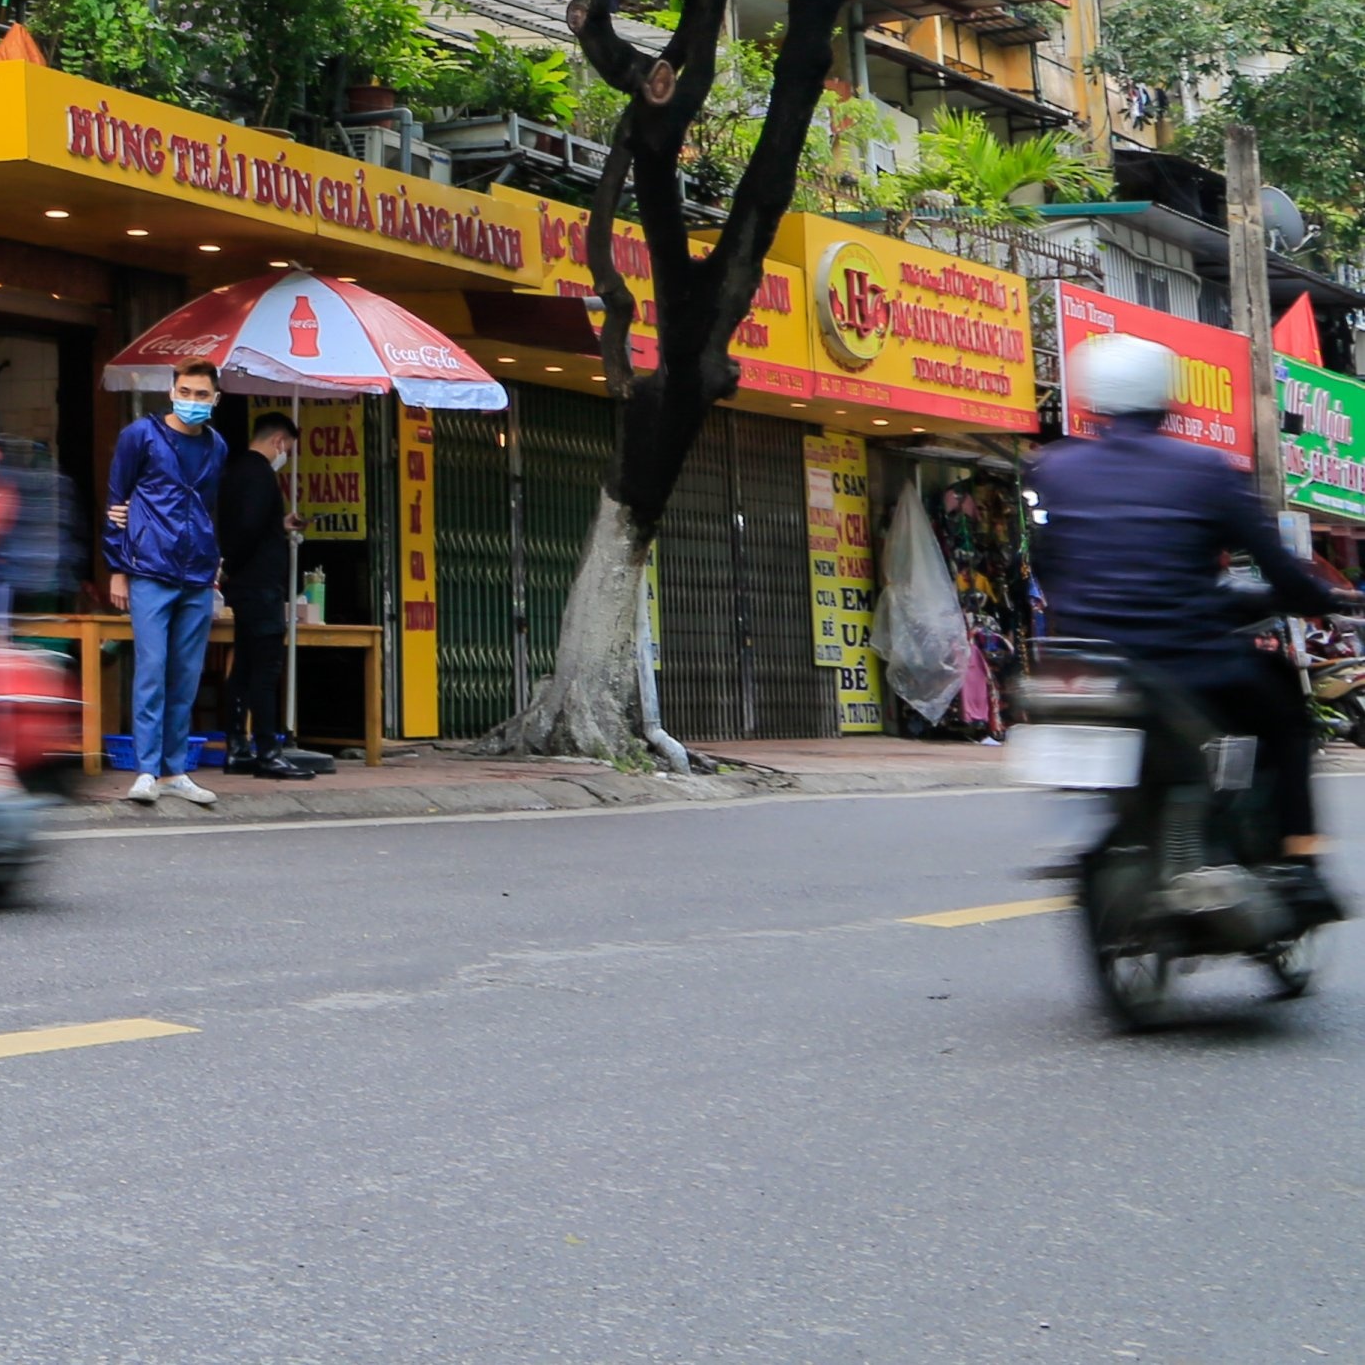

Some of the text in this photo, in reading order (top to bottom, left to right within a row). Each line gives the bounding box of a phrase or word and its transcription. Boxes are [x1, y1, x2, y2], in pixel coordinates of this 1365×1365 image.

[66, 100, 166, 176] HÙNG
[168, 134, 249, 200] THÁI
[250, 151, 313, 217] BÚN
[316, 169, 376, 232] CHẢ
[377, 184, 452, 250] HÀNG
[452, 205, 525, 270] MÀNH
[1086, 302, 1116, 333] Trang
[383, 342, 462, 370] Coca-Cola
[309, 423, 359, 458] CHẢ
[308, 470, 360, 505] MÀNH
